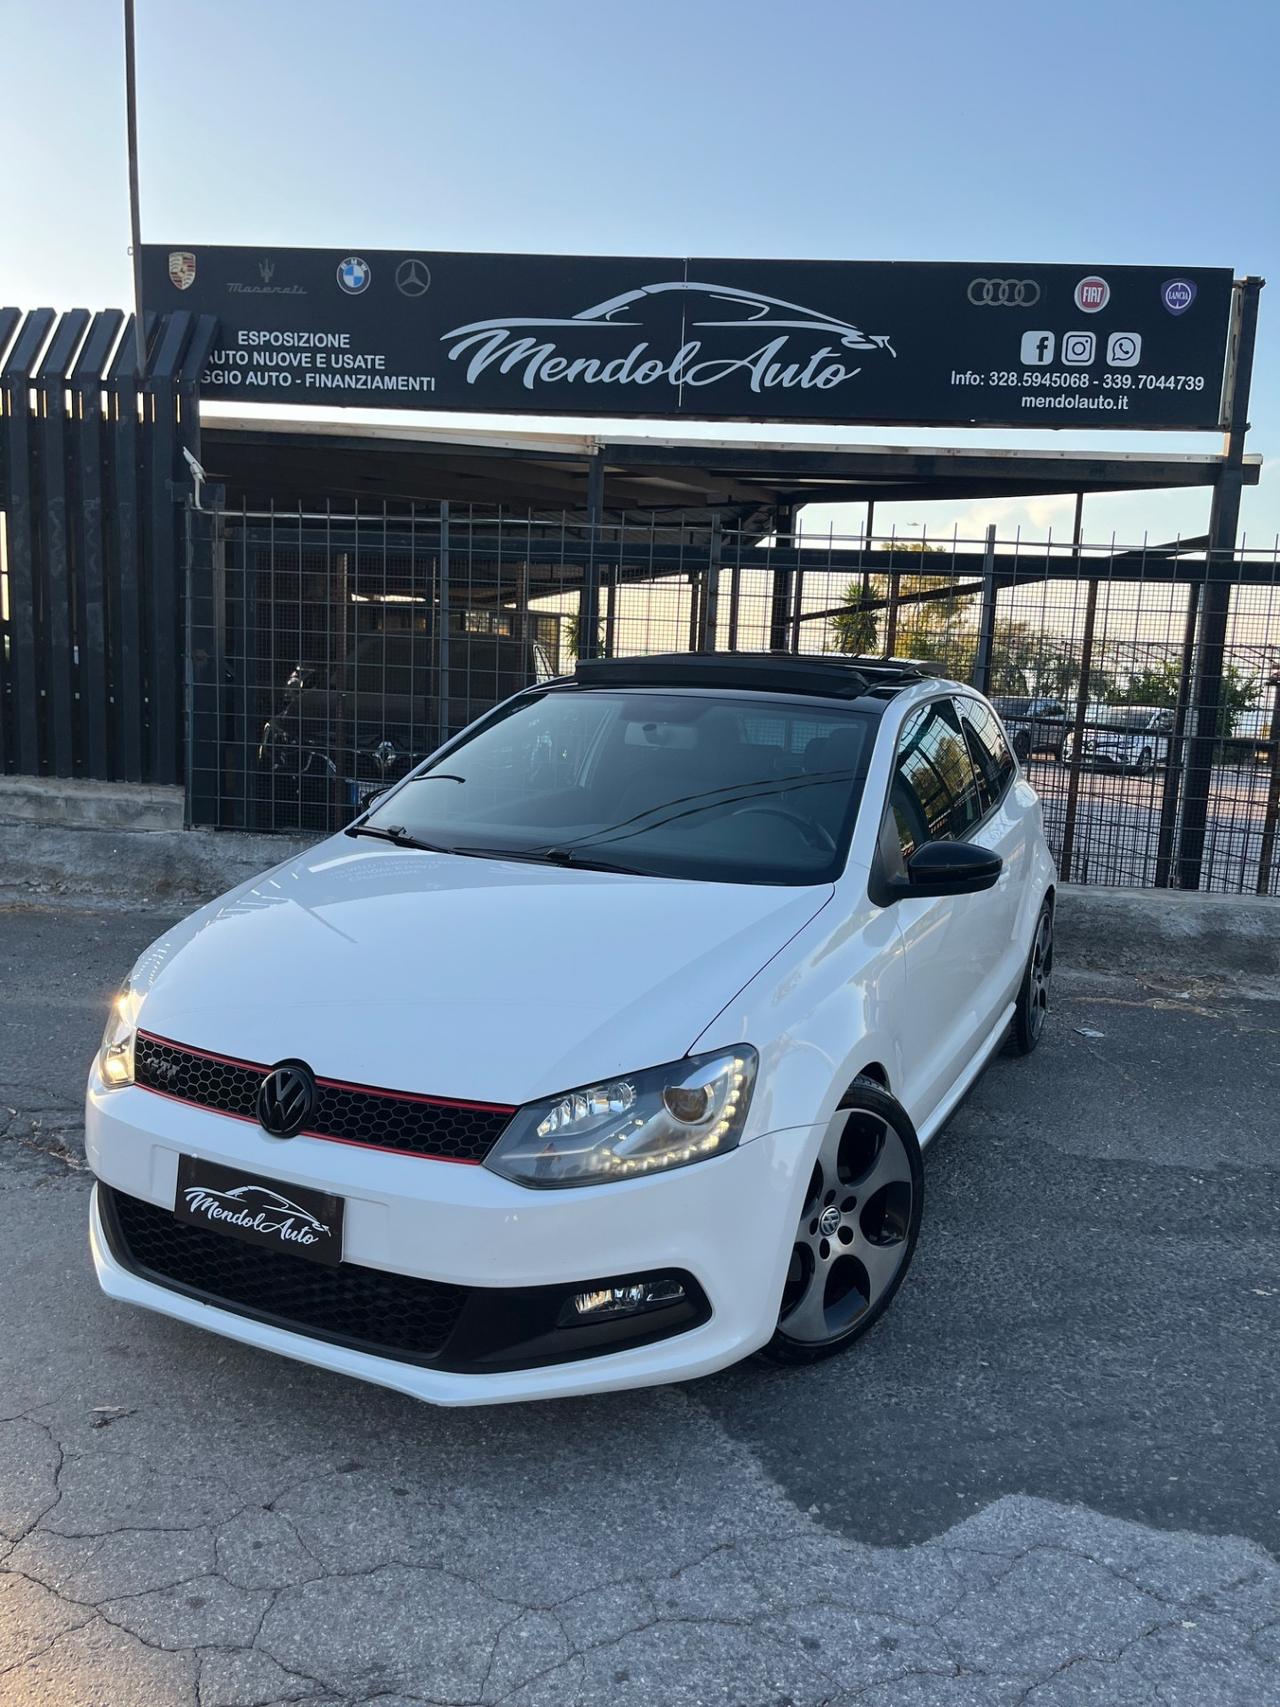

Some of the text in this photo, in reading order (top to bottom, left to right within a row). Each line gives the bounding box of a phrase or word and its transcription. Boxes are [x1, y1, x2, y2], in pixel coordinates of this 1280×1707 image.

[1082, 286, 1103, 303] FIAT
[1168, 291, 1189, 300] LANCIA
[237, 330, 351, 349] ESPOSIZIONE
[253, 351, 312, 368] NUOVE
[316, 354, 327, 368] E
[330, 355, 386, 371] USATE
[245, 371, 292, 387] AUTO
[305, 373, 436, 392] FINANZIAMENTI
[950, 370, 985, 386] Info:
[989, 371, 1090, 388] 328.5945068
[1103, 373, 1205, 391] 339.7044739
[1021, 393, 1129, 411] mendolauto.it
